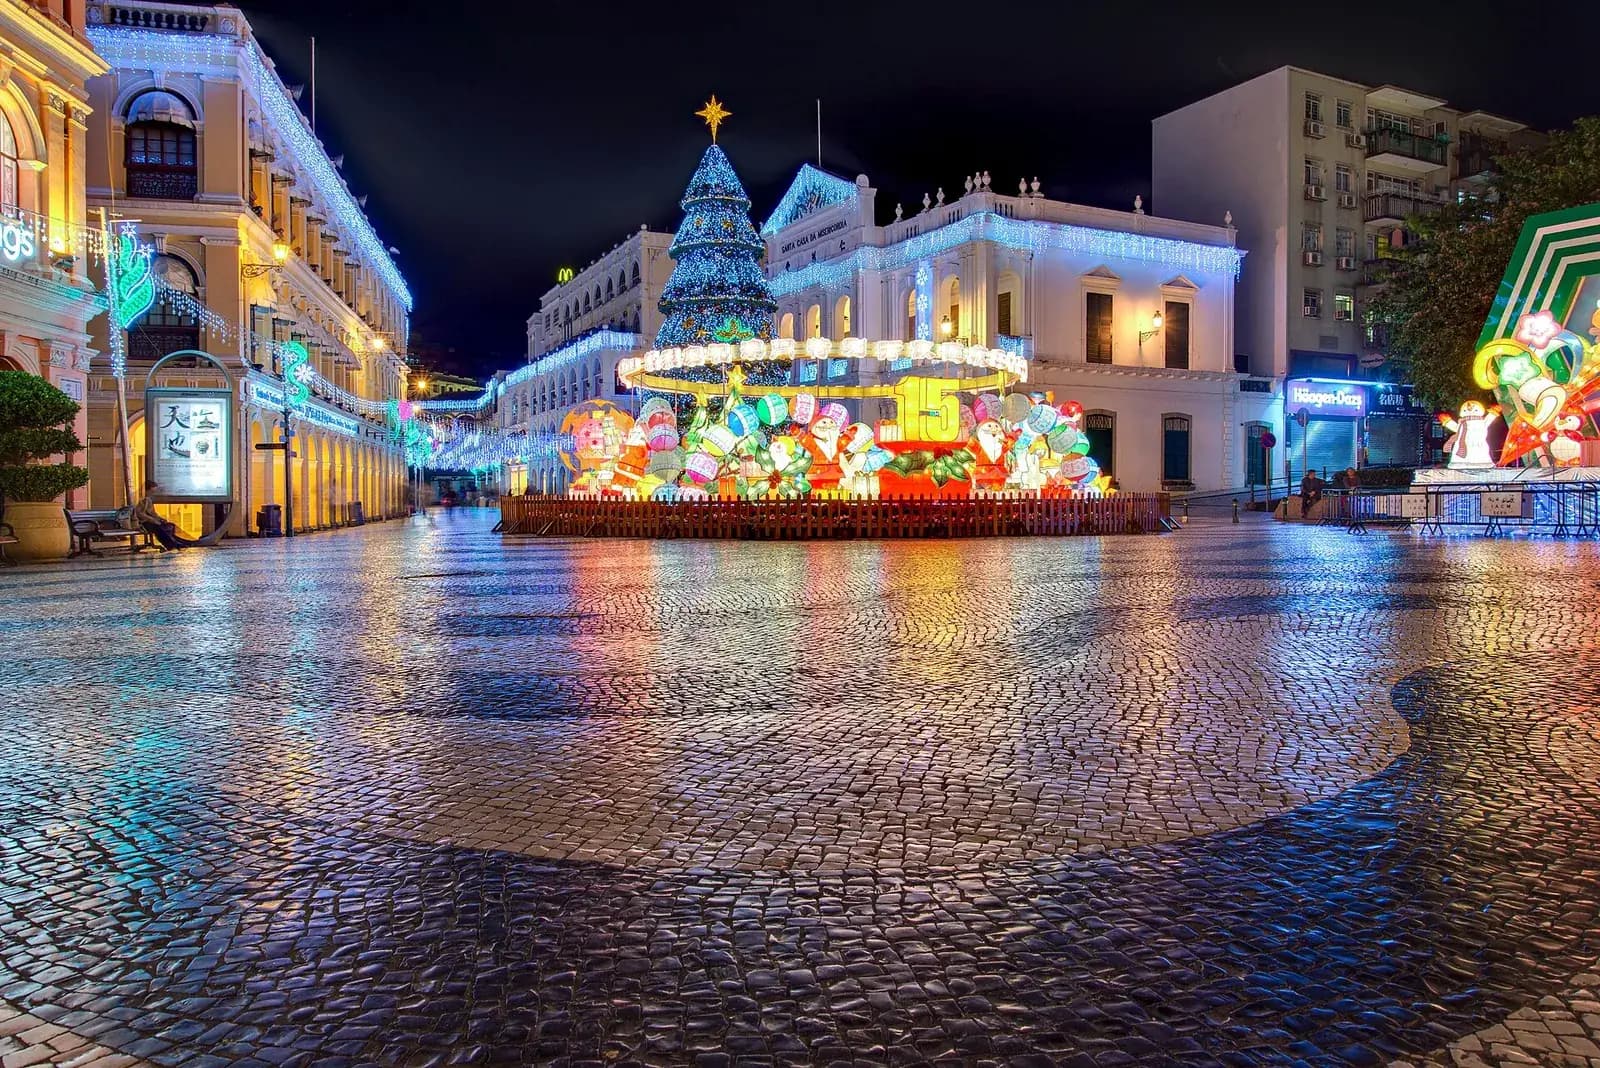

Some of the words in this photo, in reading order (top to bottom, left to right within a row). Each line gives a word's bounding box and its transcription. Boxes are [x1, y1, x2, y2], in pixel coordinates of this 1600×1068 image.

[0, 223, 34, 260] gs
[782, 243, 795, 253] SANTA
[796, 236, 809, 247] CASA
[810, 232, 817, 242] DA
[894, 376, 960, 441] 15
